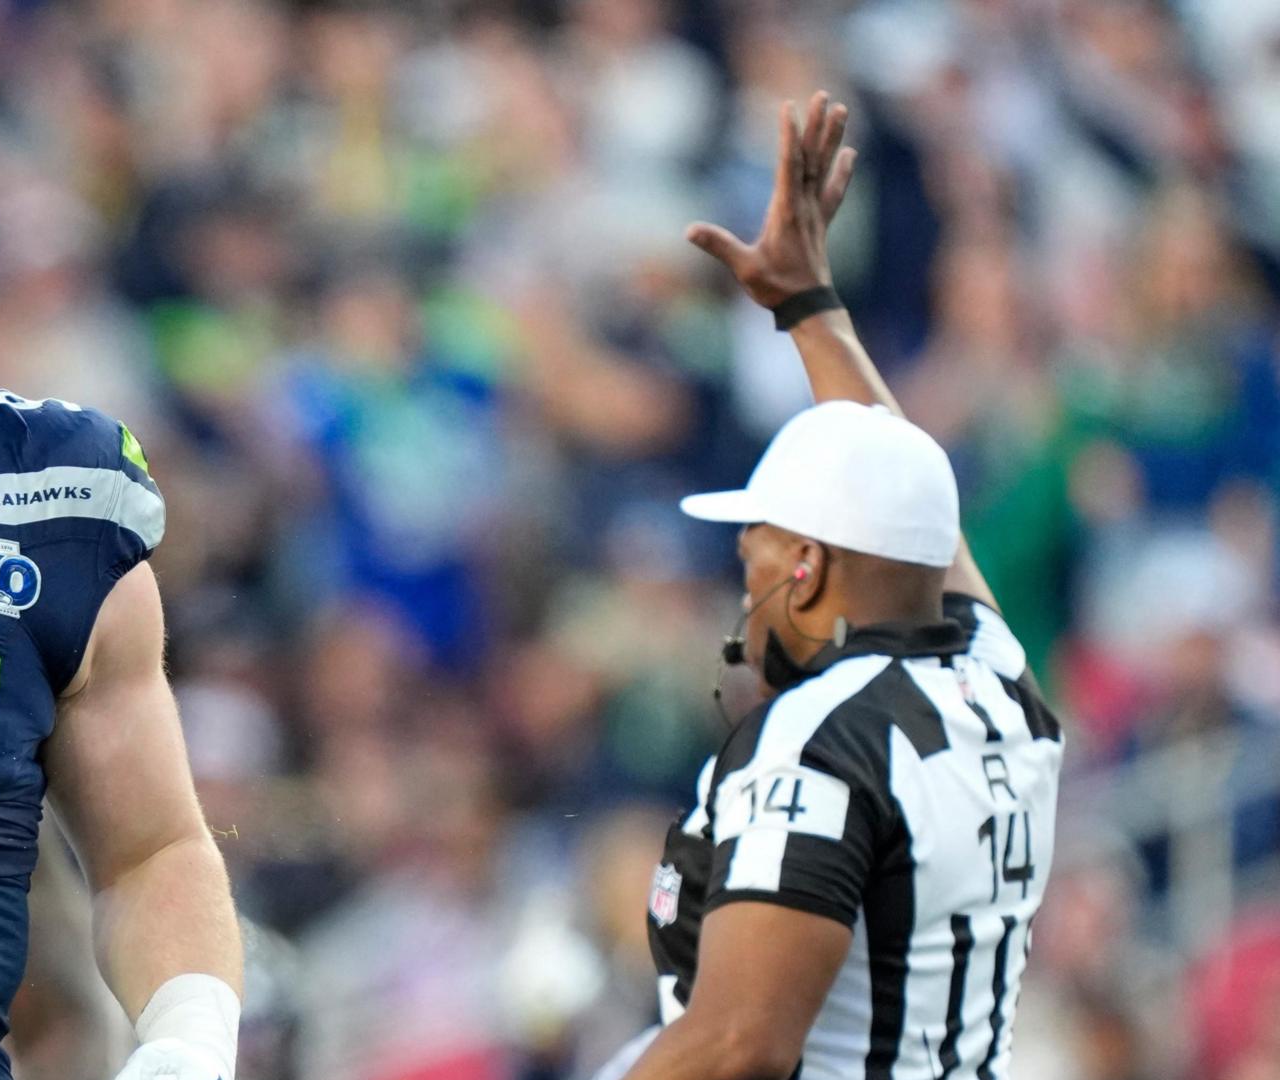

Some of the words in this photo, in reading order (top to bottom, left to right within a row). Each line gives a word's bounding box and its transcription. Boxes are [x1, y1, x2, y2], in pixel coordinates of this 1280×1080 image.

[740, 777, 807, 824] 14
[982, 754, 1017, 801] R
[978, 811, 1034, 904] 14
